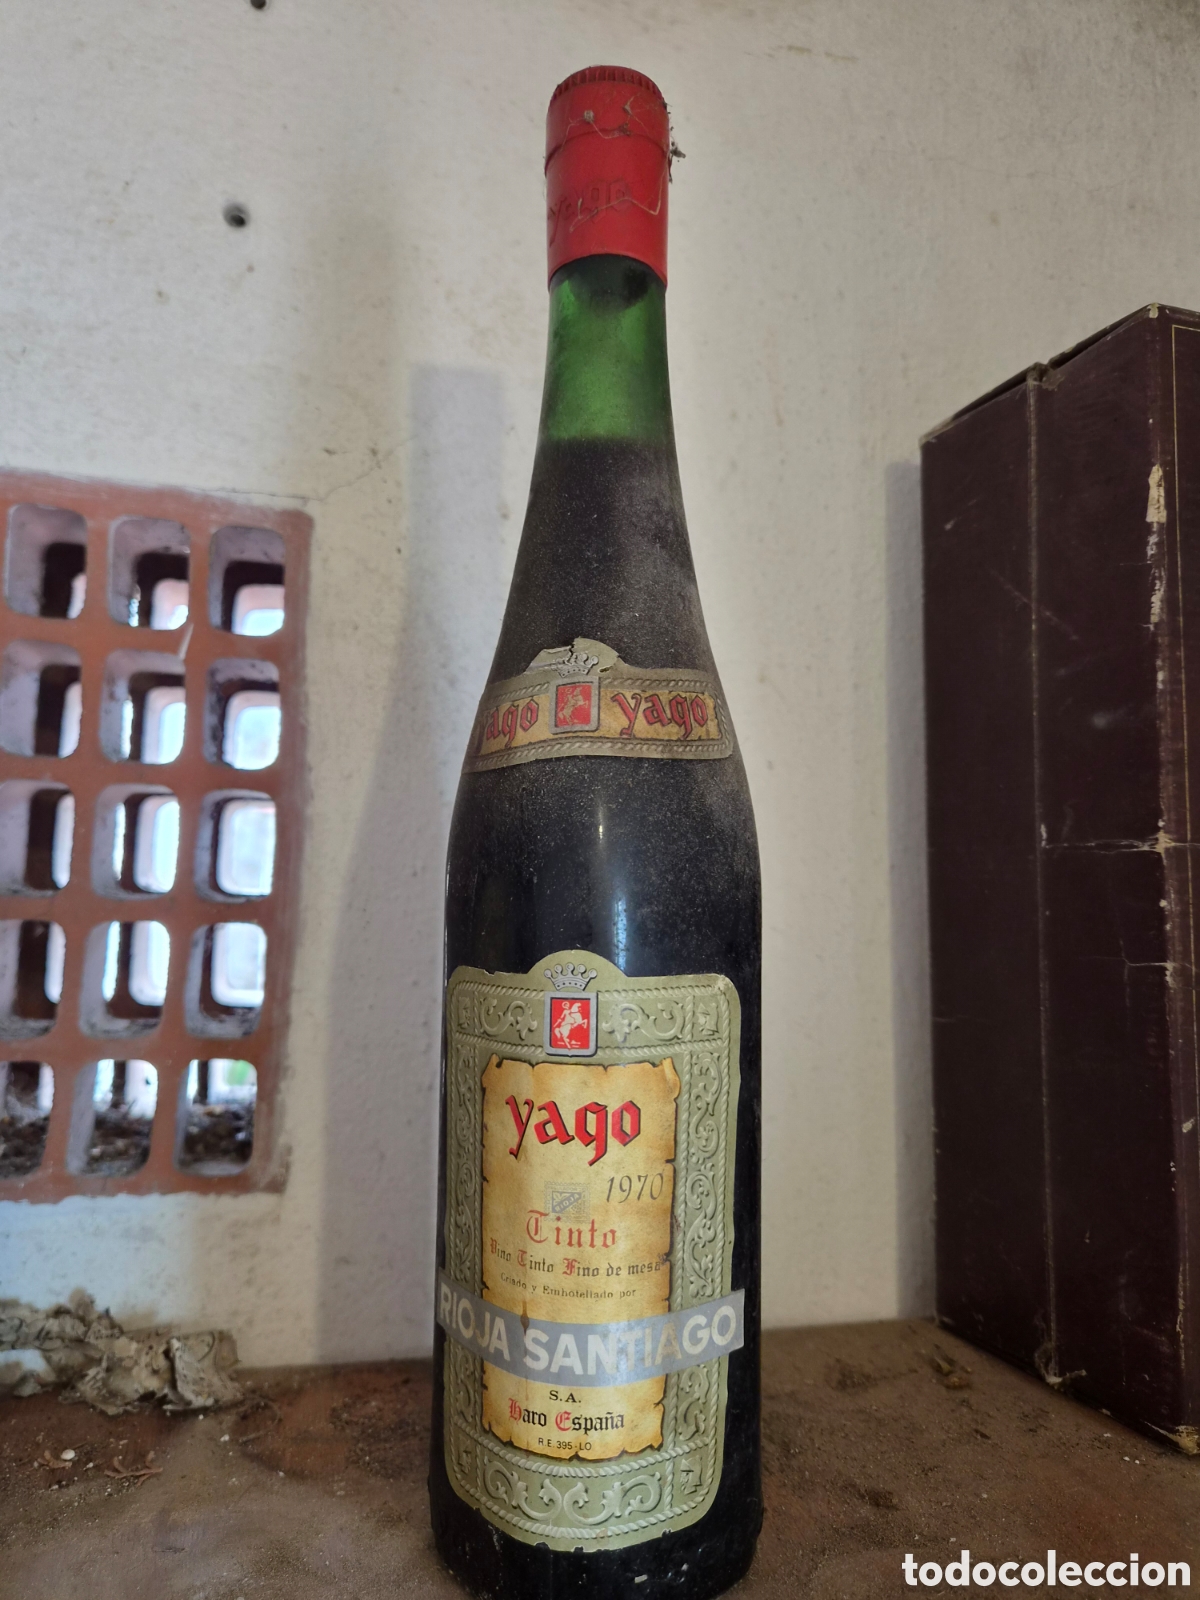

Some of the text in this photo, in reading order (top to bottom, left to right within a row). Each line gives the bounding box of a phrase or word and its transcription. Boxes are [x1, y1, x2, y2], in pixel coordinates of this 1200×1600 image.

[554, 1193, 580, 1212] RIOJA
[605, 1172, 664, 1204] 1970
[526, 1209, 617, 1249] Tinto
[517, 1249, 554, 1273] Tinto
[562, 1257, 600, 1278] Fino
[606, 1263, 622, 1277] de
[627, 1260, 661, 1275] mesa
[500, 1272, 637, 1300] Criado y Embotellado por
[439, 1282, 737, 1376] RIOJA SANTIAGO
[508, 1397, 625, 1436] Haro España
